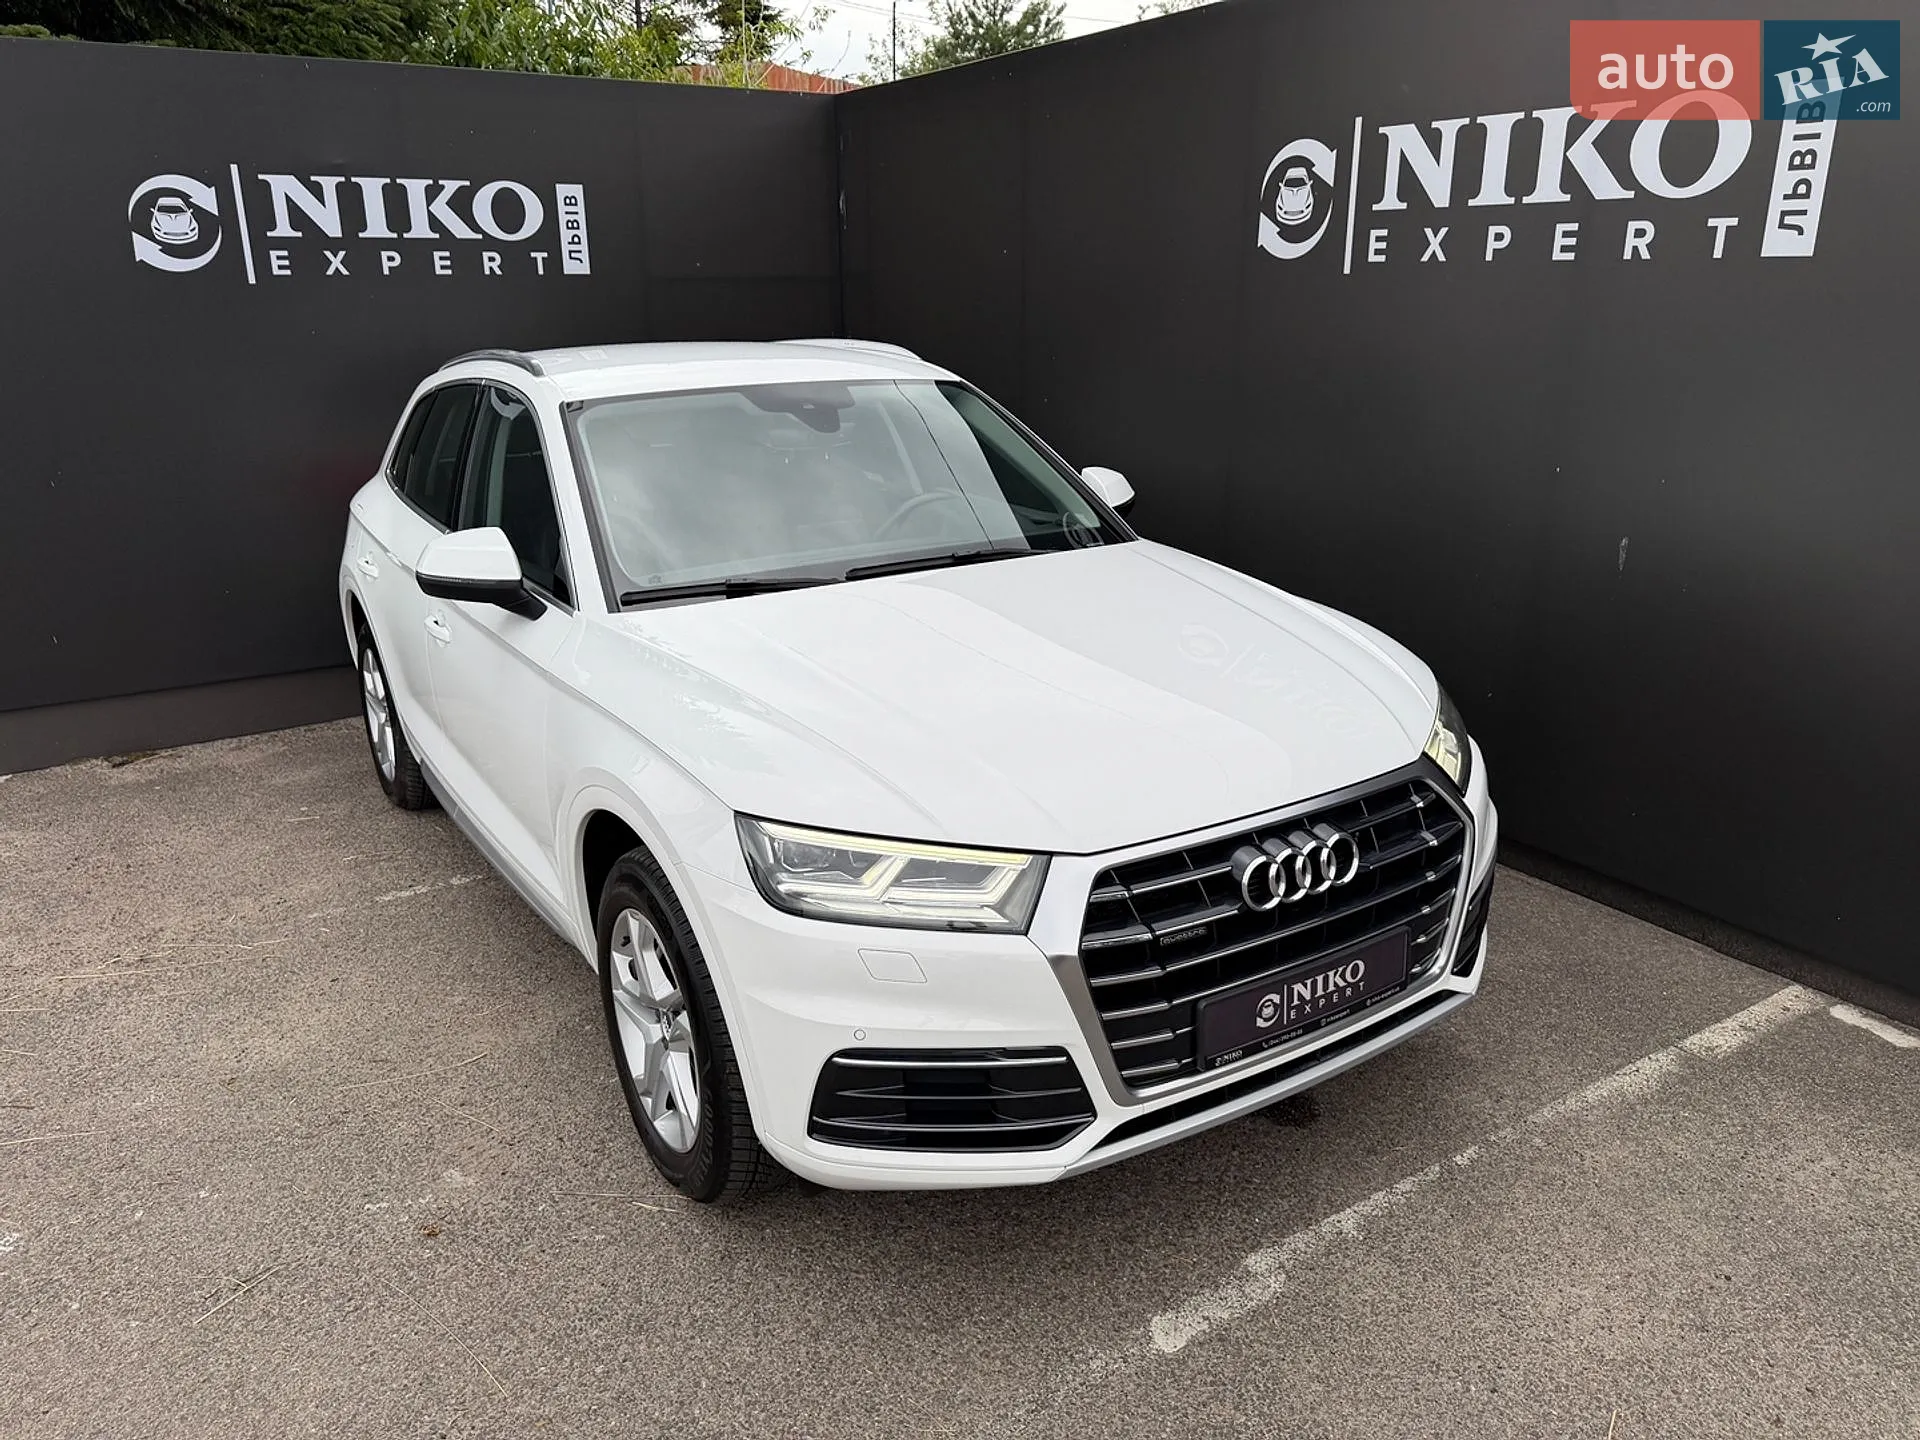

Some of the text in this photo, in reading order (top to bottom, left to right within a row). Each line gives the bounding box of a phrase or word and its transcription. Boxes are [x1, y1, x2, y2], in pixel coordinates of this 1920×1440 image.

[1371, 89, 1752, 212] NIKO
[1777, 99, 1827, 237] ЛЬВІВ
[257, 173, 545, 242] NIKO
[563, 194, 584, 264] ЛЬВІВ
[269, 249, 548, 276] EXPERT
[1367, 216, 1740, 264] EXPERT
[1290, 959, 1366, 1007] NIKO
[1290, 981, 1366, 1020] EXPERT
